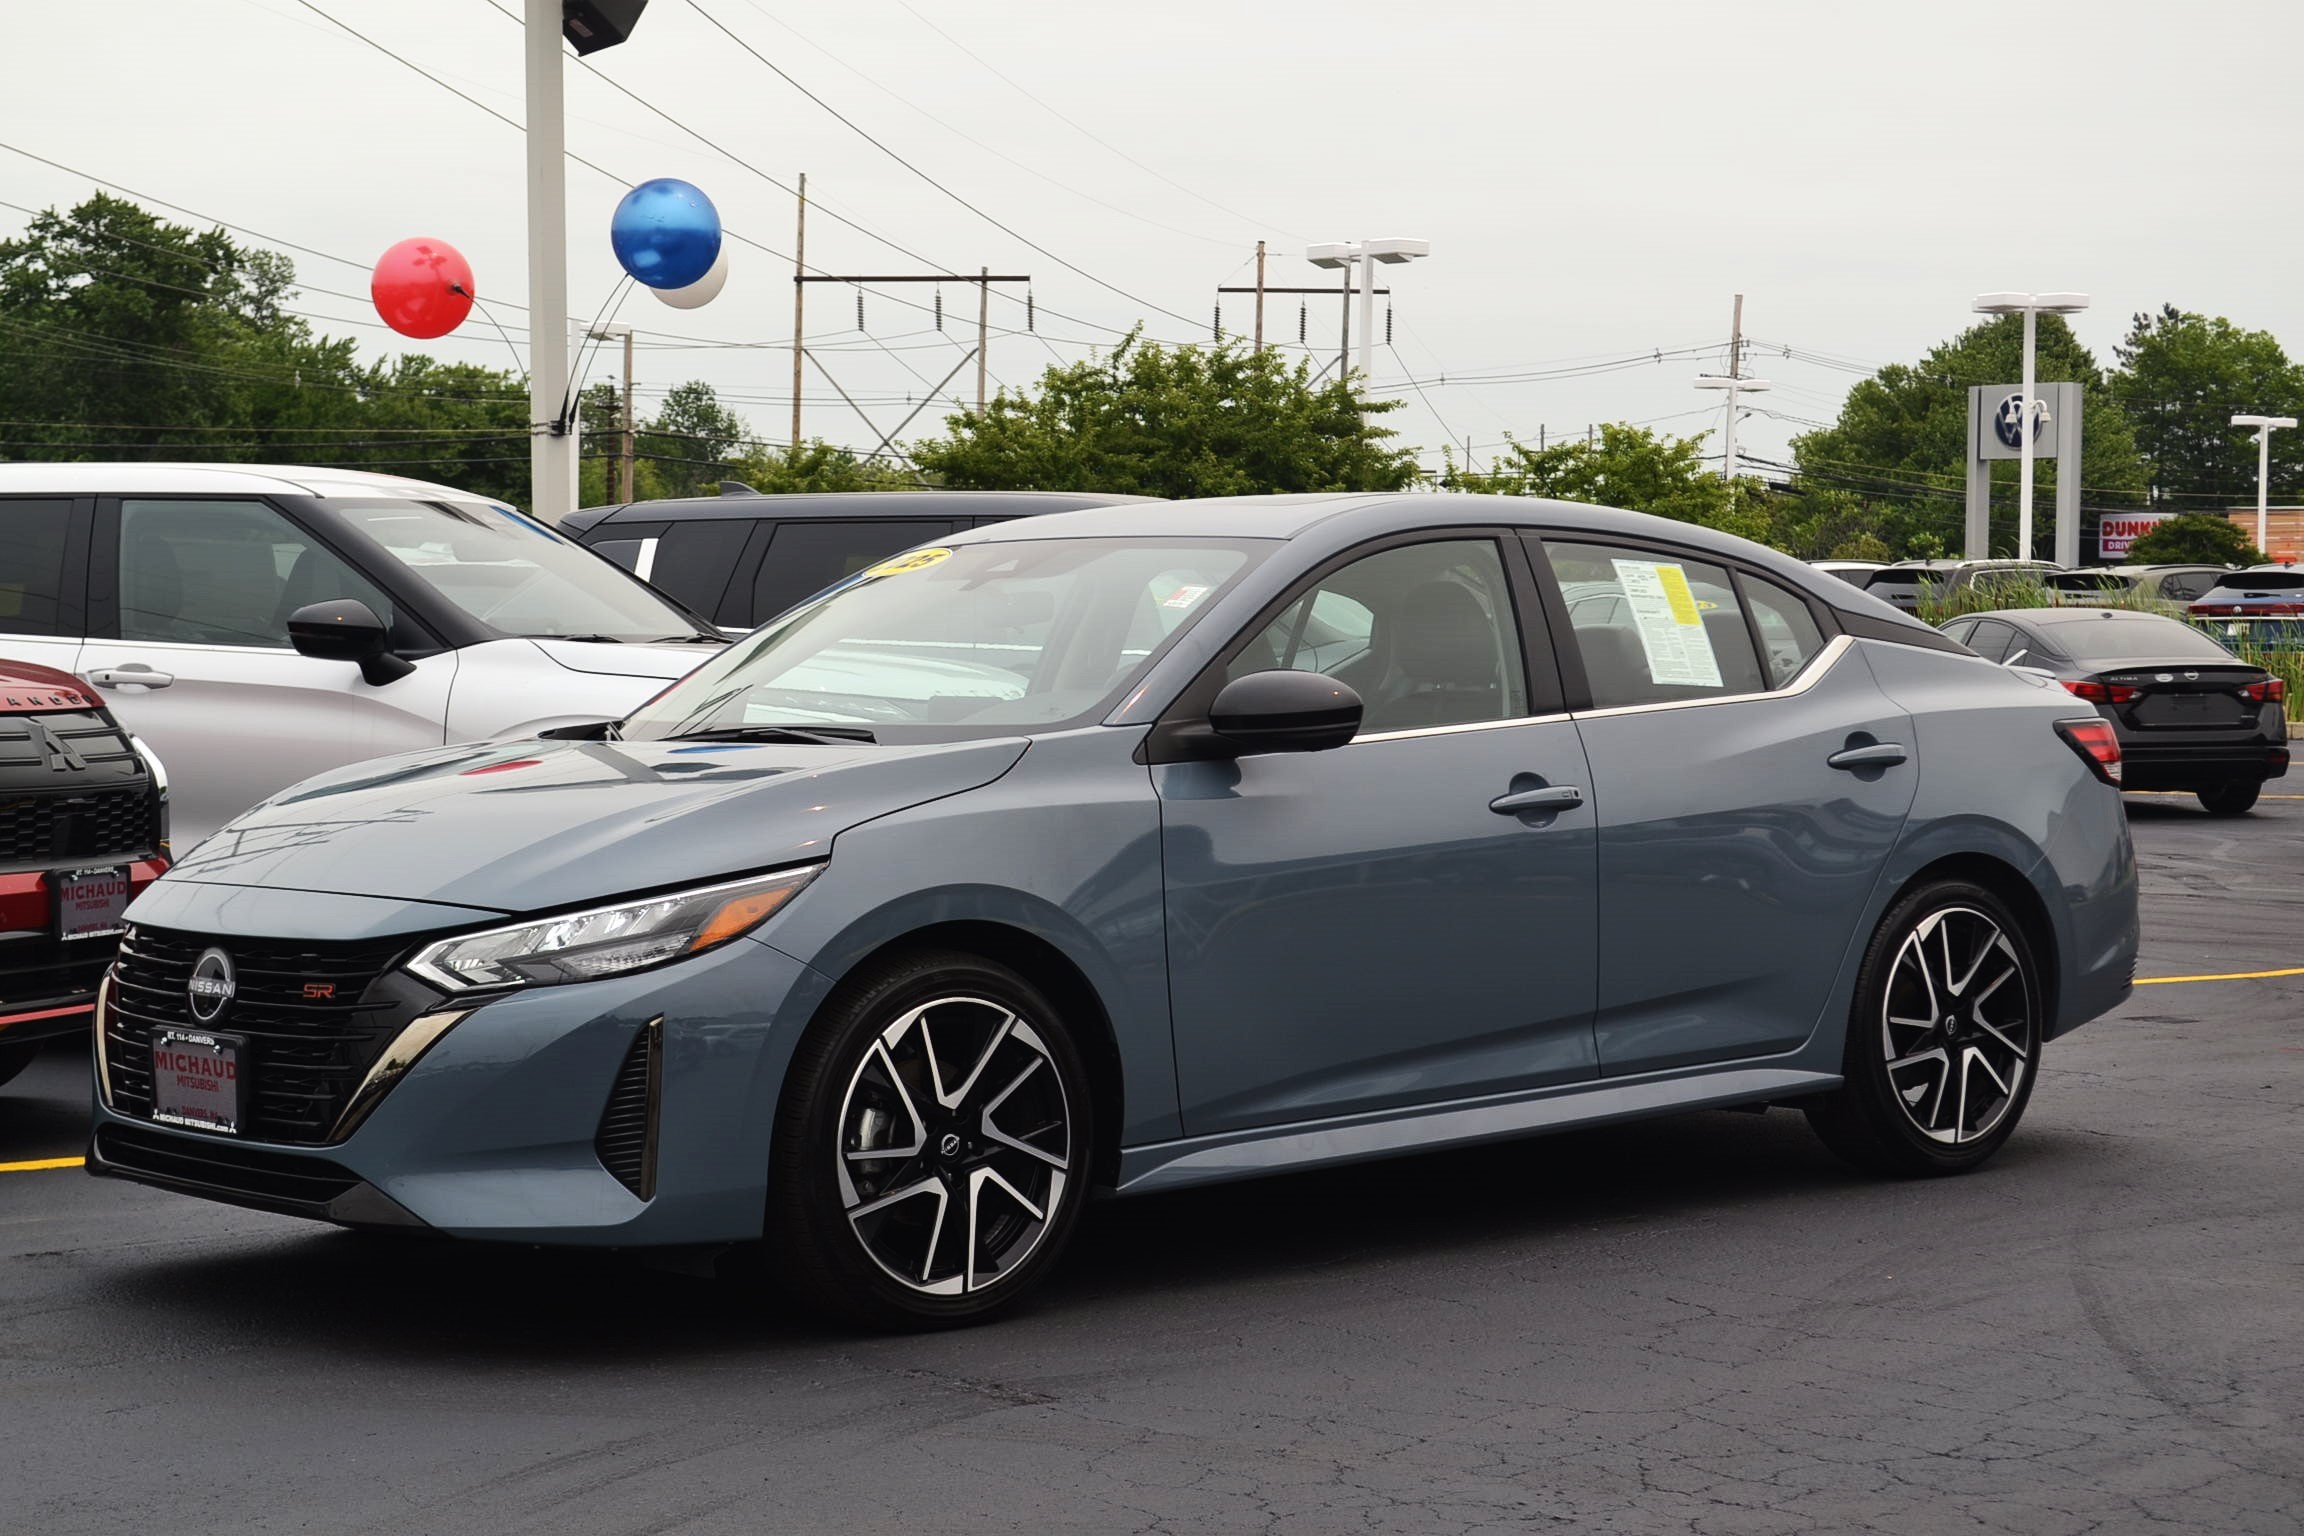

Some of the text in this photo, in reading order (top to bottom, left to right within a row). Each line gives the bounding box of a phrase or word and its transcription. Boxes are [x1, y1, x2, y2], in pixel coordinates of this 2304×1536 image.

[61, 881, 126, 902] MICHAUD
[188, 978, 233, 995] NISSAN
[303, 983, 335, 999] SR
[155, 1051, 237, 1081] MICHAUD
[176, 1075, 221, 1093] MITSUBISHI
